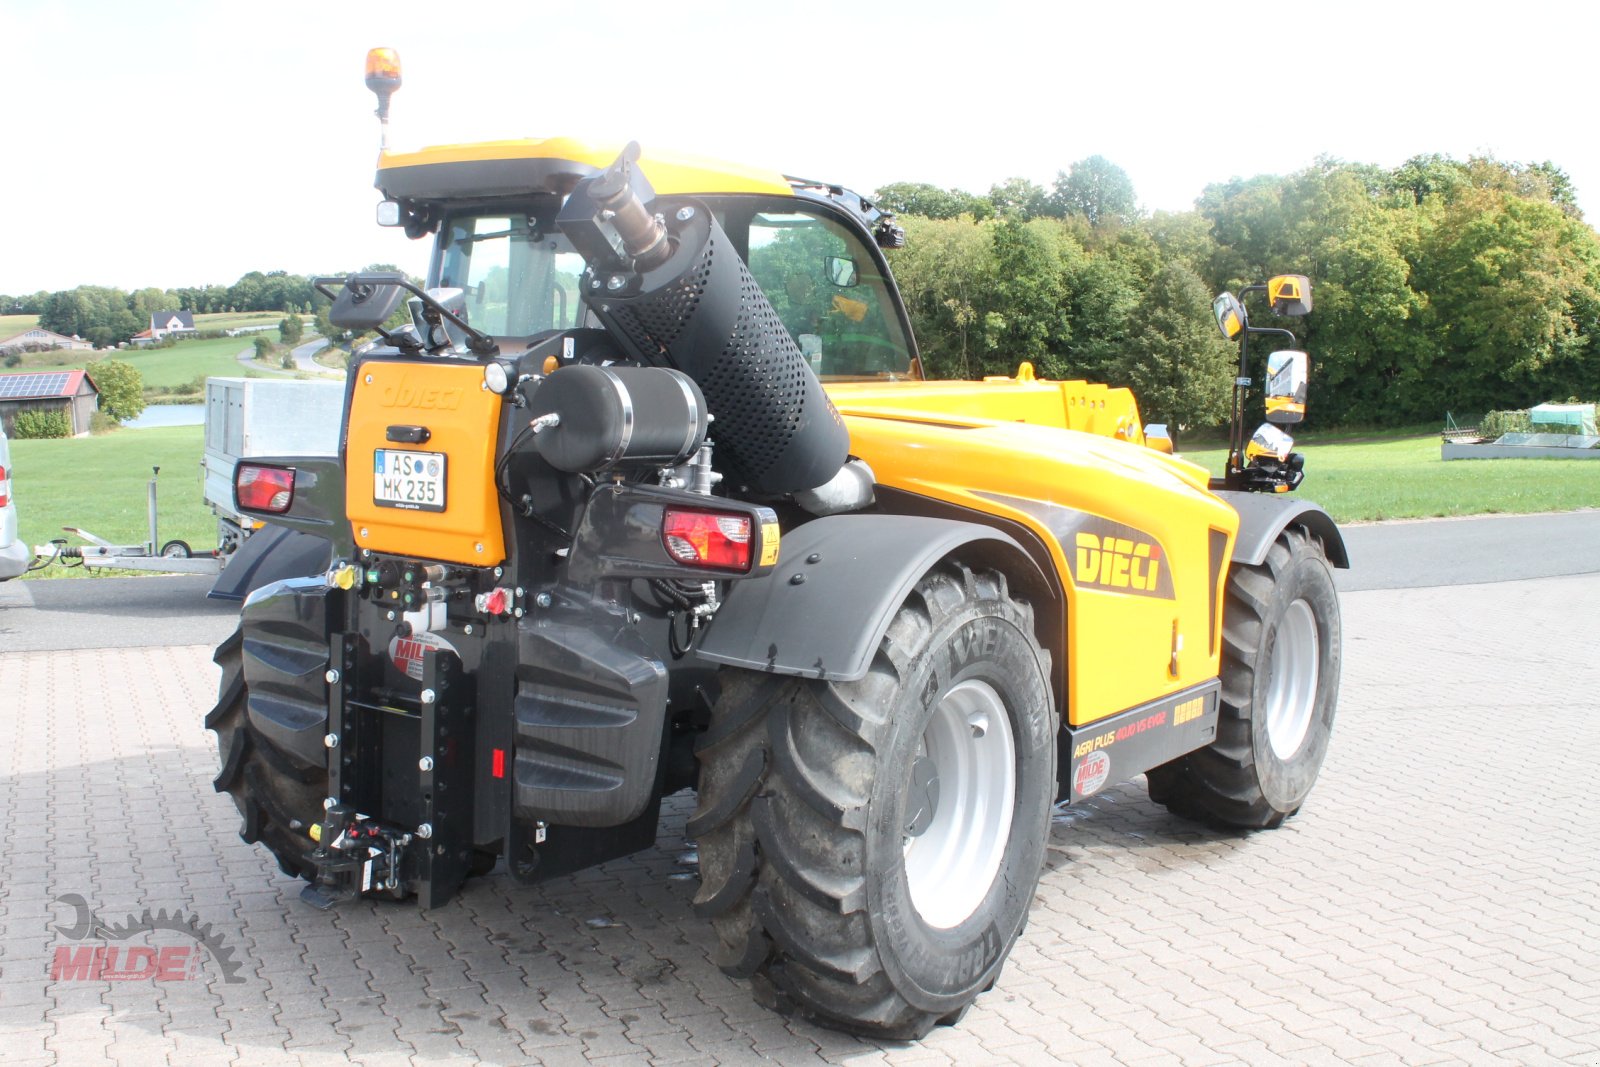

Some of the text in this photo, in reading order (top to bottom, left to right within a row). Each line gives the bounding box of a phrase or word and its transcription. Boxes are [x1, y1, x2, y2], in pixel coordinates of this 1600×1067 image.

[393, 455, 412, 476] AS
[384, 478, 436, 502] MK 235
[1074, 739, 1094, 759] AGRI
[1094, 730, 1116, 750] PLUS
[1077, 758, 1105, 784] MILDE
